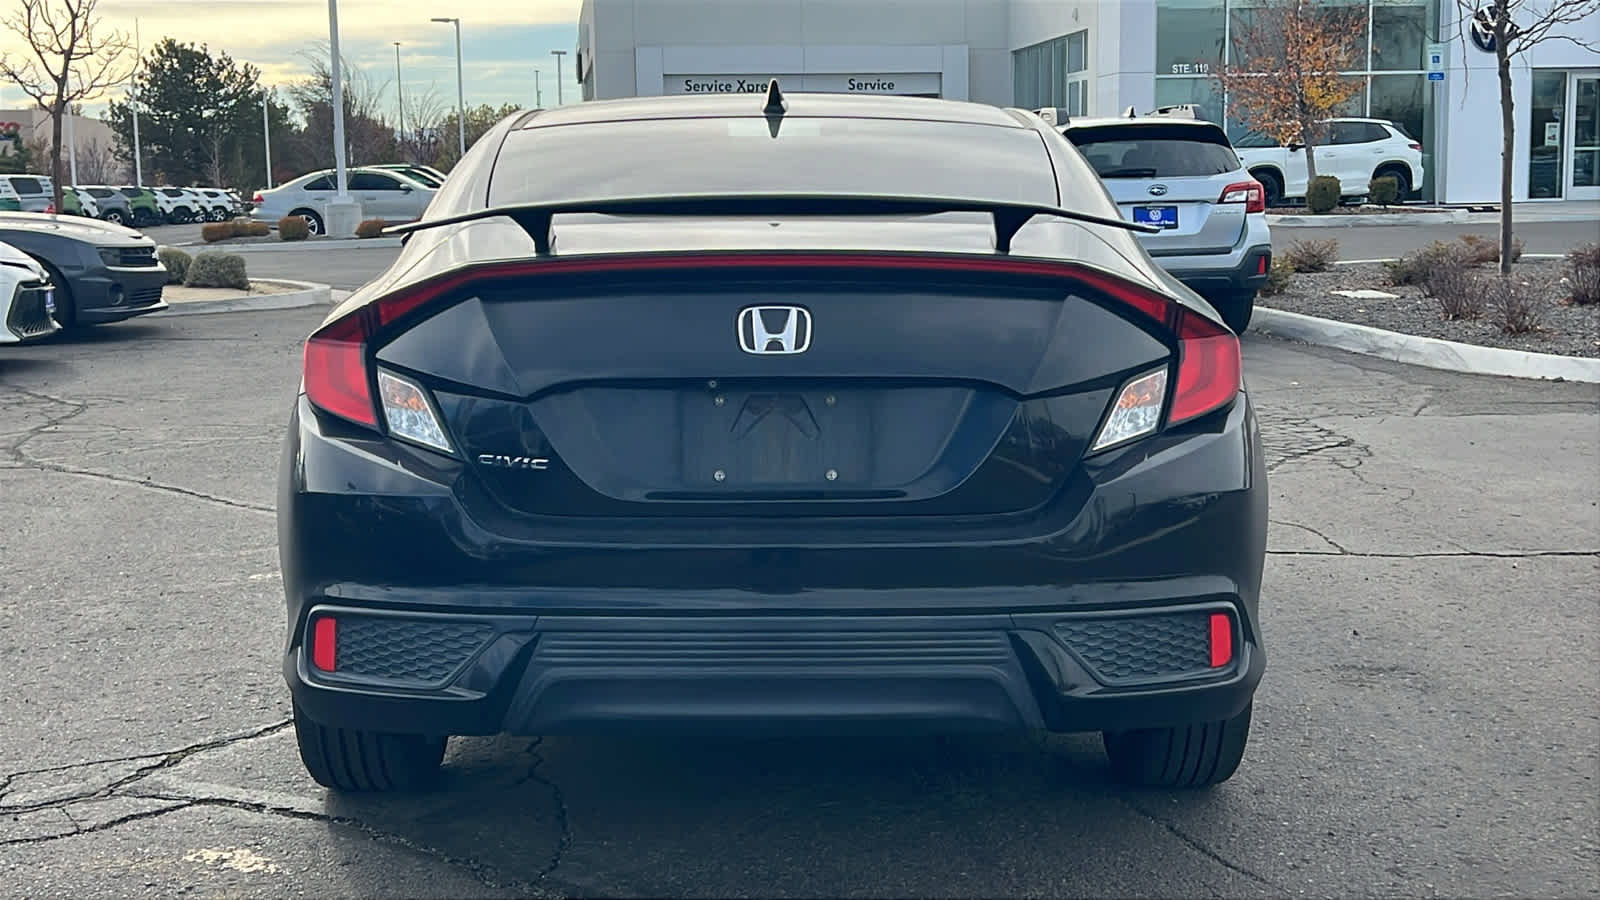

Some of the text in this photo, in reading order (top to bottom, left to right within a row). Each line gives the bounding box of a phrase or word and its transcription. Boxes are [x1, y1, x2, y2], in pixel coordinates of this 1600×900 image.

[685, 79, 768, 93] Service Xpre
[848, 78, 895, 90] Service
[478, 454, 550, 470] CIVIC
